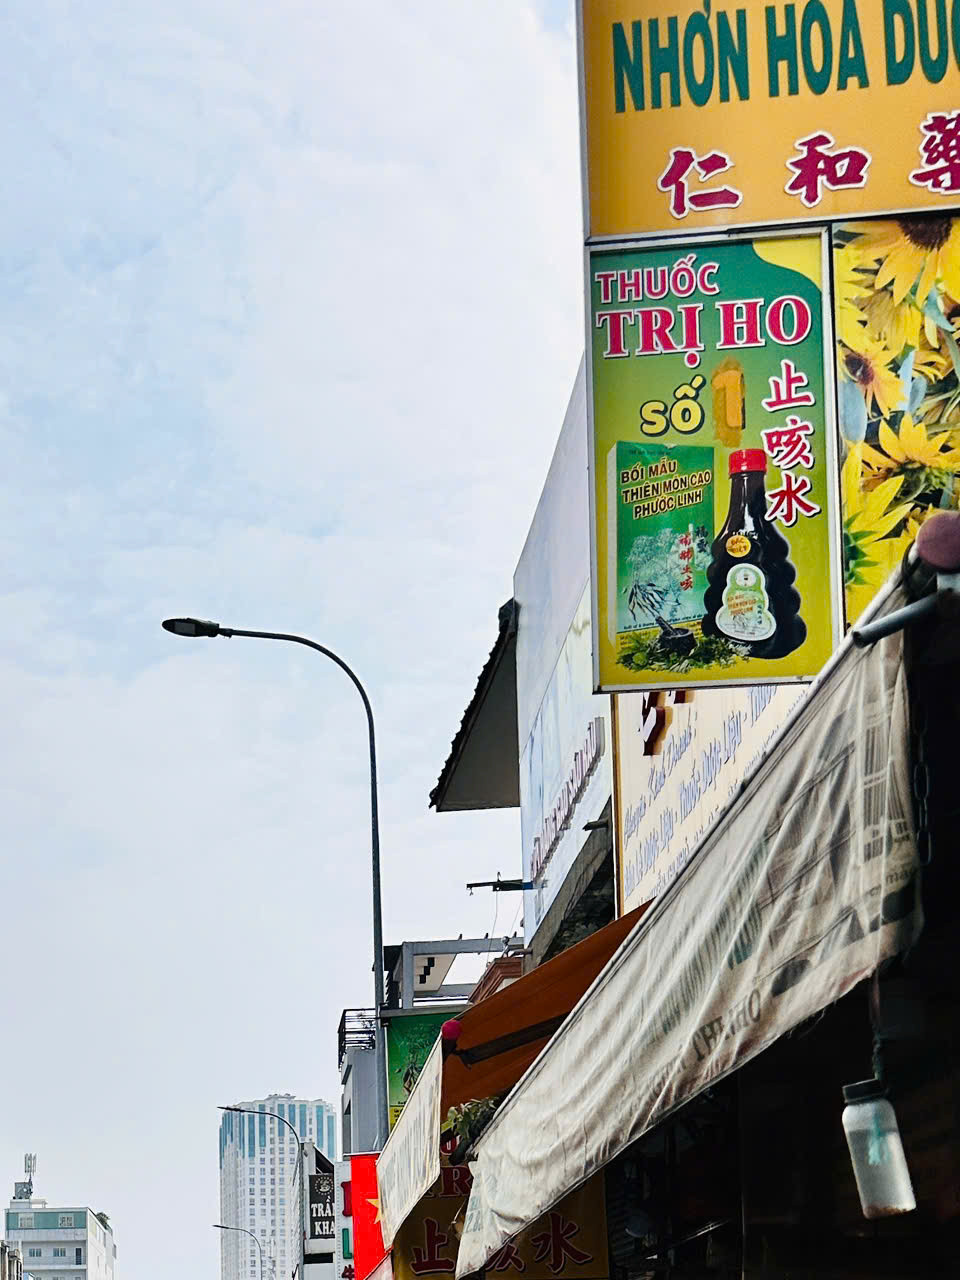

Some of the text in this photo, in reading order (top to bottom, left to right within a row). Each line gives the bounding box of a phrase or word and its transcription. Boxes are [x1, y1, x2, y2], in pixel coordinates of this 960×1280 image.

[595, 254, 720, 304] THUỐC
[595, 295, 812, 368] TRỊ HO
[761, 359, 821, 527] 止咳水
[621, 462, 645, 484] BỐI
[622, 469, 712, 503] THIÊN MÔN CAO
[677, 488, 702, 508] LINH
[311, 1195, 335, 1217] TRẦ
